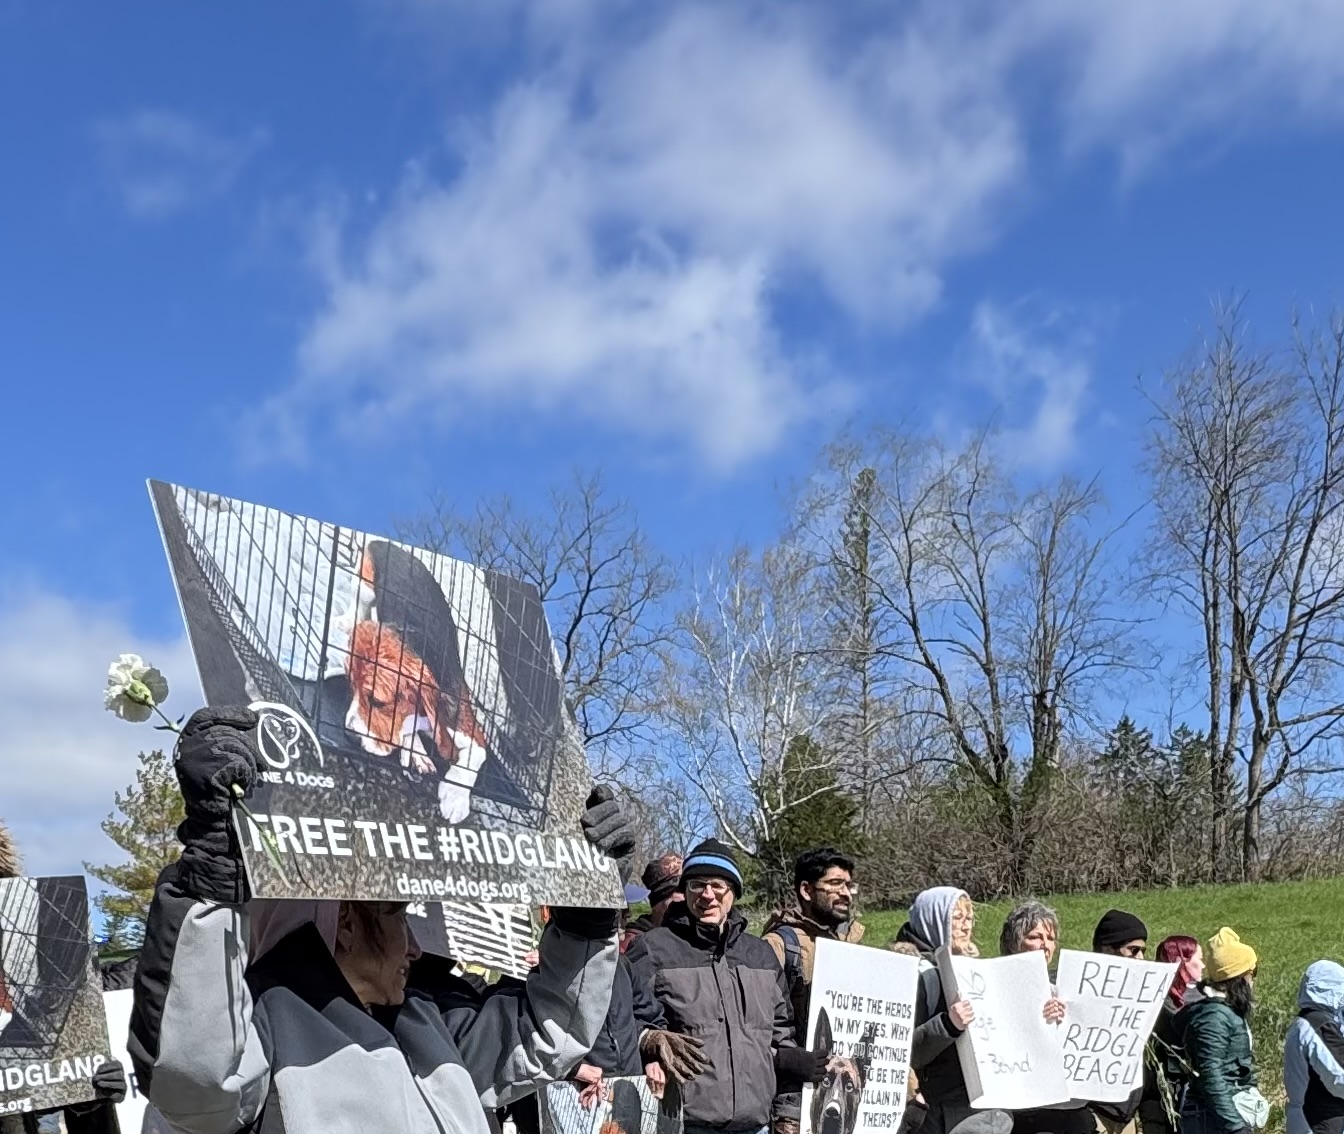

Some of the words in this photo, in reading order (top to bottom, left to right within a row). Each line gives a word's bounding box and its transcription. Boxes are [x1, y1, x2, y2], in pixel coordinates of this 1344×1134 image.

[285, 770, 295, 784] 4
[296, 771, 335, 788] DOGS
[246, 813, 352, 857] FREE
[353, 820, 434, 861] THE
[397, 873, 532, 904] dane4dogs.org
[866, 998, 883, 1015] THE
[1109, 1005, 1146, 1030] THE
[834, 1016, 844, 1033] IN
[846, 1018, 862, 1035] MY
[891, 1022, 911, 1041] WHY
[866, 1042, 908, 1063] CONTINUE
[876, 1067, 888, 1083] BE
[890, 1068, 906, 1085] THE
[892, 1091, 902, 1107] IN
